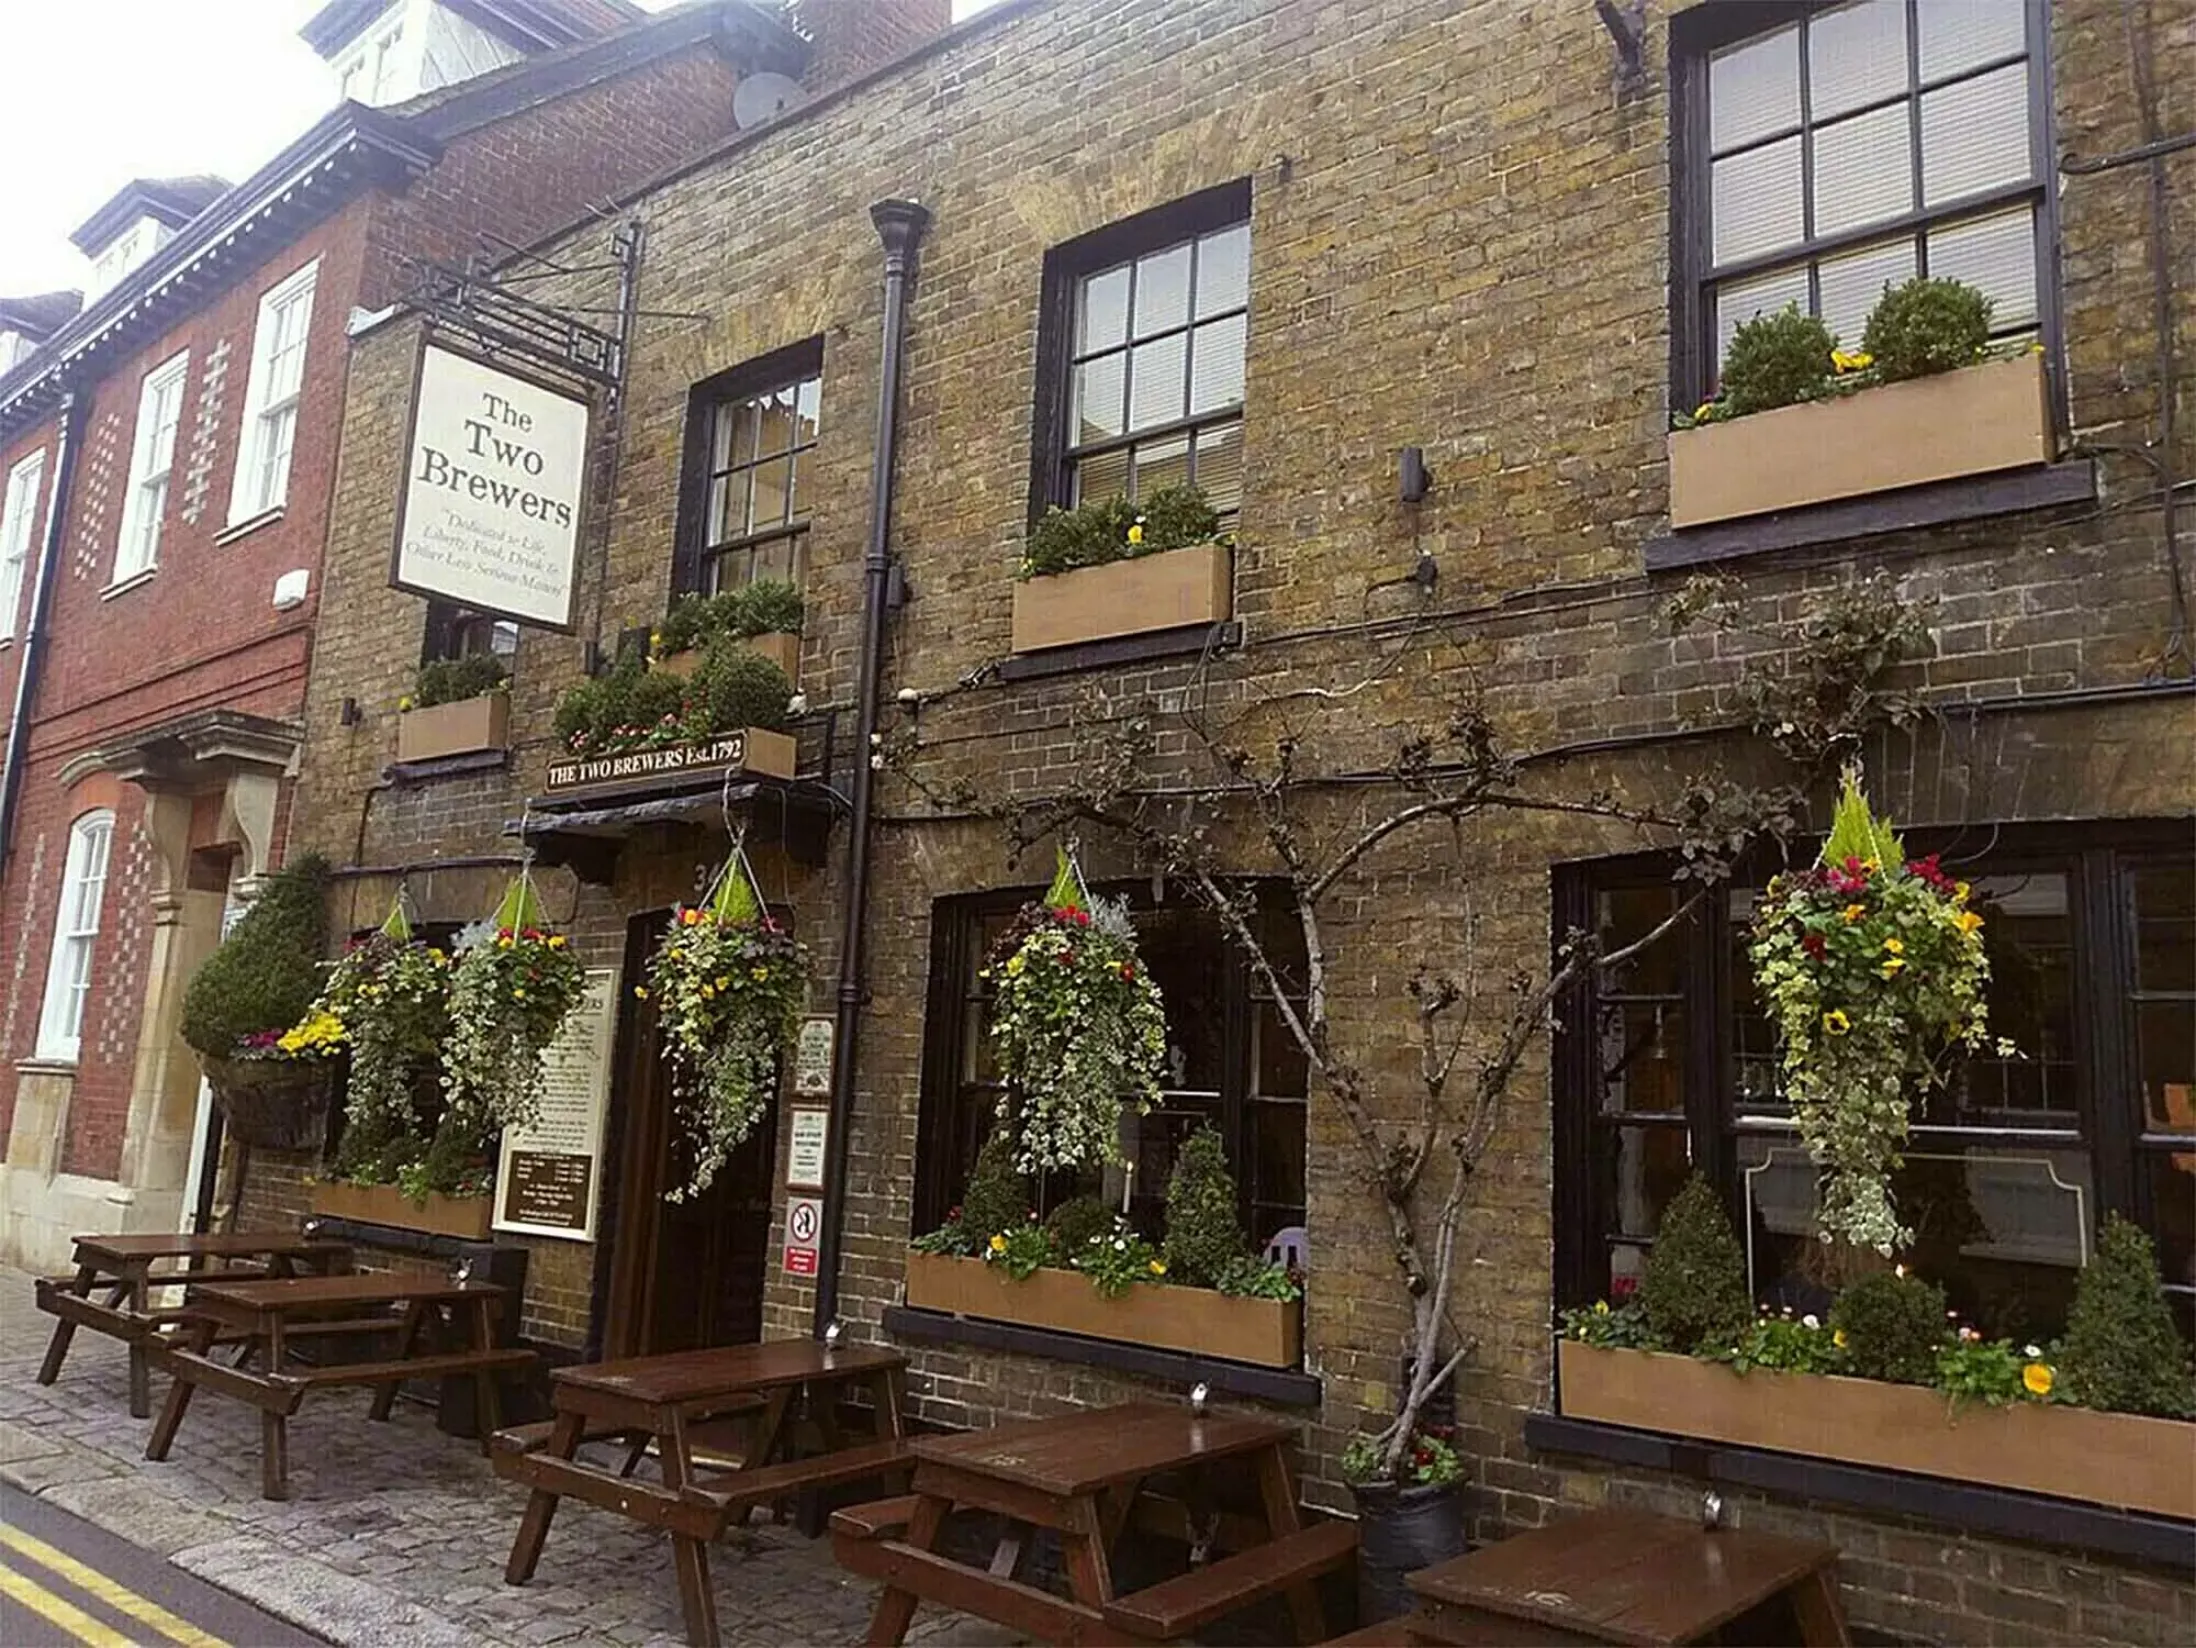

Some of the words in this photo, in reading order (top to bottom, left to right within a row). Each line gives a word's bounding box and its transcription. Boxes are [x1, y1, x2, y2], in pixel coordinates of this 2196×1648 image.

[482, 392, 533, 433] The
[464, 419, 544, 476] Two
[417, 445, 573, 530] Brewers
[549, 765, 577, 784] THE
[579, 759, 611, 780] TWO
[613, 748, 684, 776] BREWERS
